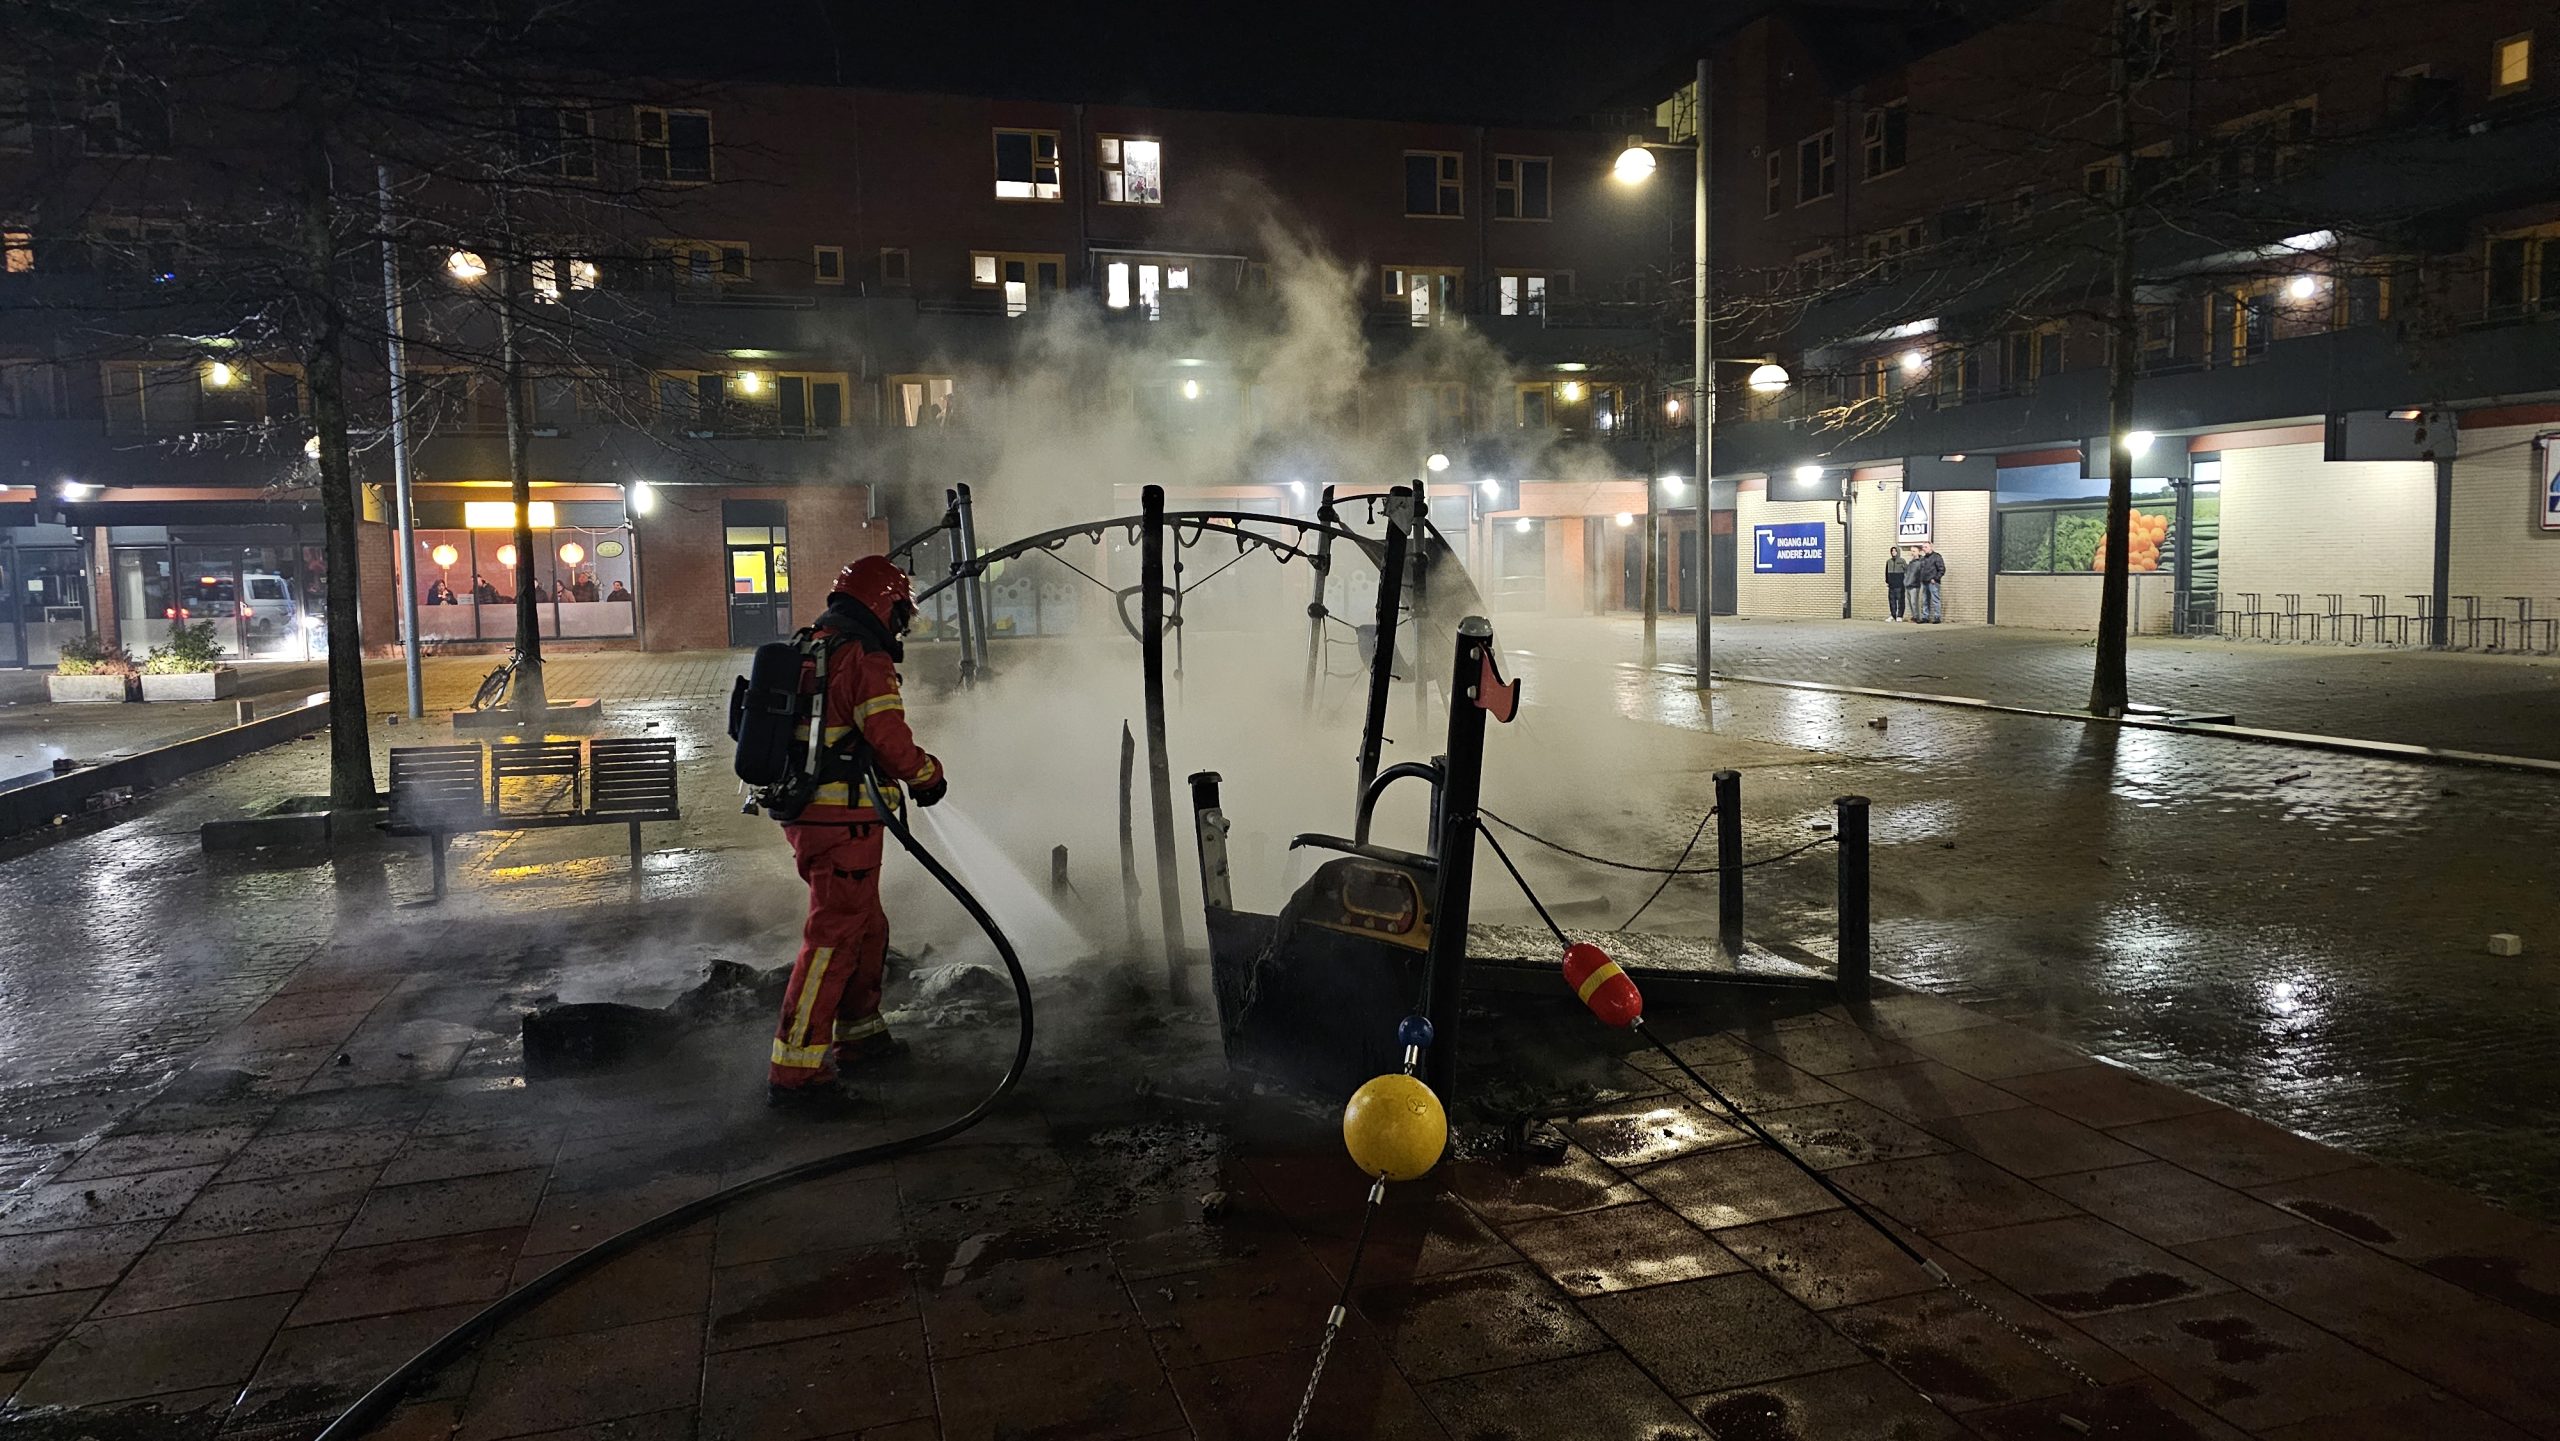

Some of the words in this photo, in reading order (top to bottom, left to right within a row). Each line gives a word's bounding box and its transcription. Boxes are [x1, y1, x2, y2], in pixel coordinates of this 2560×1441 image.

[1902, 524, 1926, 534] ALDI
[1777, 537, 1802, 547] INGANG
[1803, 536, 1817, 547] ALDI
[1777, 549, 1803, 559] ANDERE
[1803, 549, 1822, 559] ZIJDE
